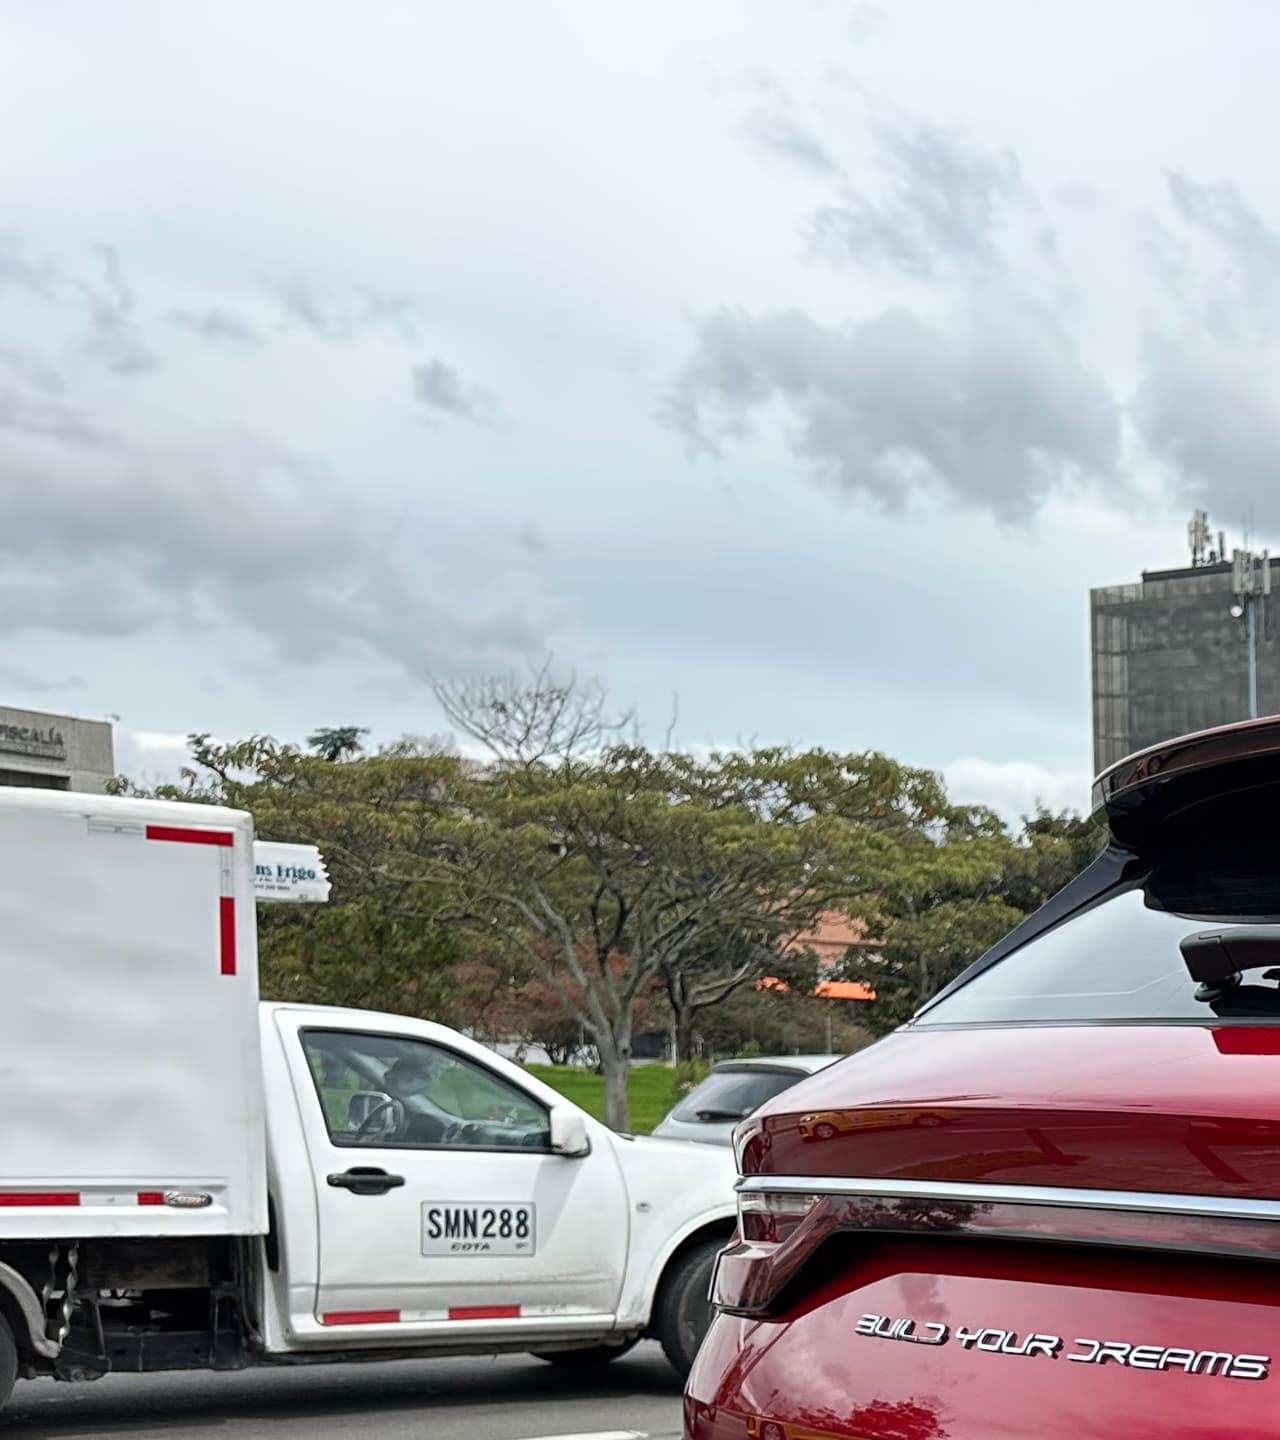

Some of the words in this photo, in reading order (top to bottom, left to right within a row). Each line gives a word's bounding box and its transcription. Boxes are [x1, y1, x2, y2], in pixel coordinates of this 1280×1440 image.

[428, 1208, 530, 1239] SMN288
[855, 1313, 948, 1345] BUILD
[955, 1326, 1062, 1358] YOUR
[1066, 1338, 1271, 1379] DREAMS
